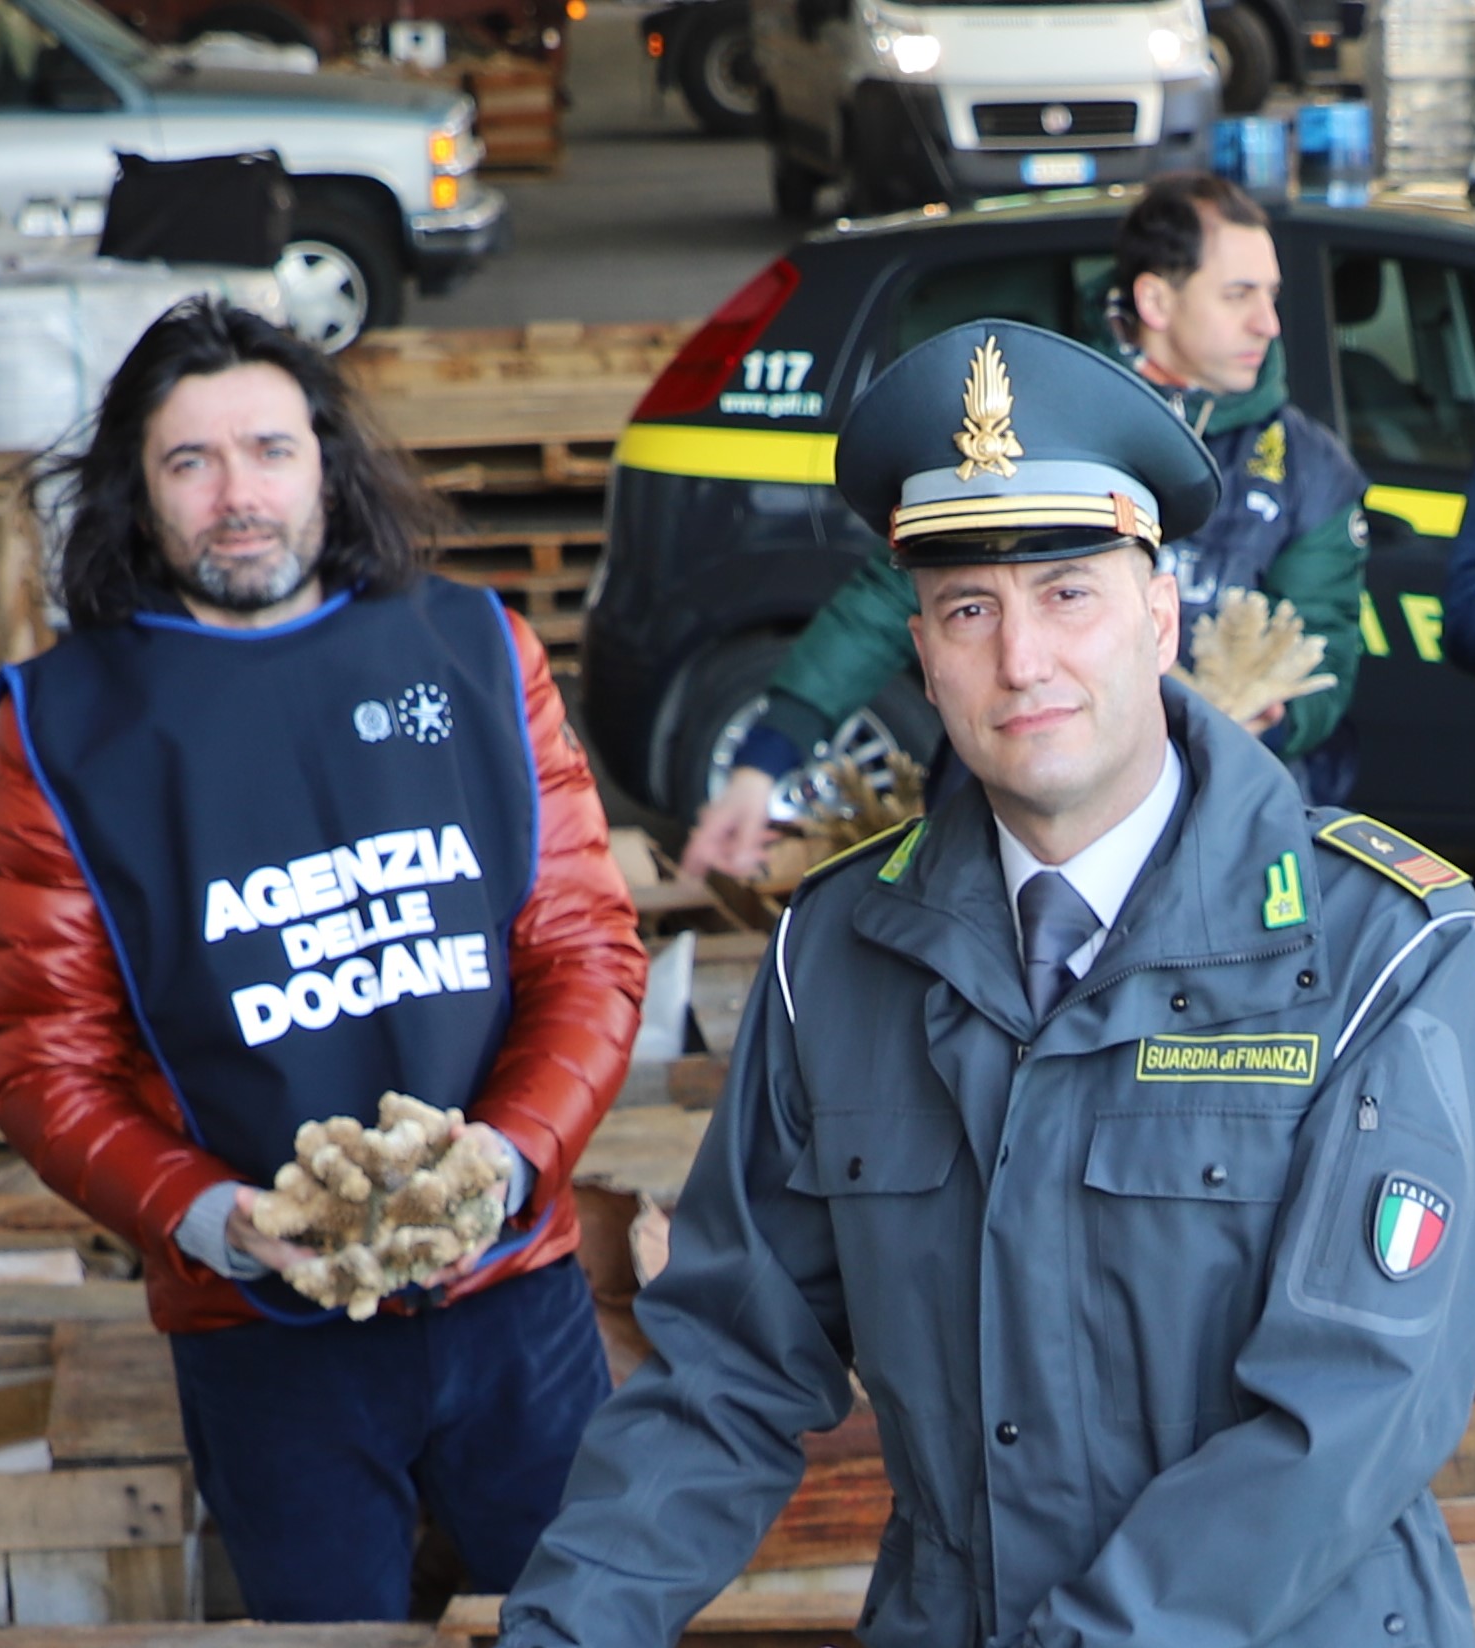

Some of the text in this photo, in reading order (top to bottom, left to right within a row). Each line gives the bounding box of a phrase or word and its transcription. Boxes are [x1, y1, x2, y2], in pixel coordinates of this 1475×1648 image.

[742, 350, 814, 390] 117
[204, 823, 482, 943] AGENZIA
[281, 889, 436, 971] DELLE
[232, 933, 491, 1048] DOGANE
[1146, 1045, 1308, 1073] GUARDIA di FINANZA
[1391, 1181, 1445, 1218] ITALIA
